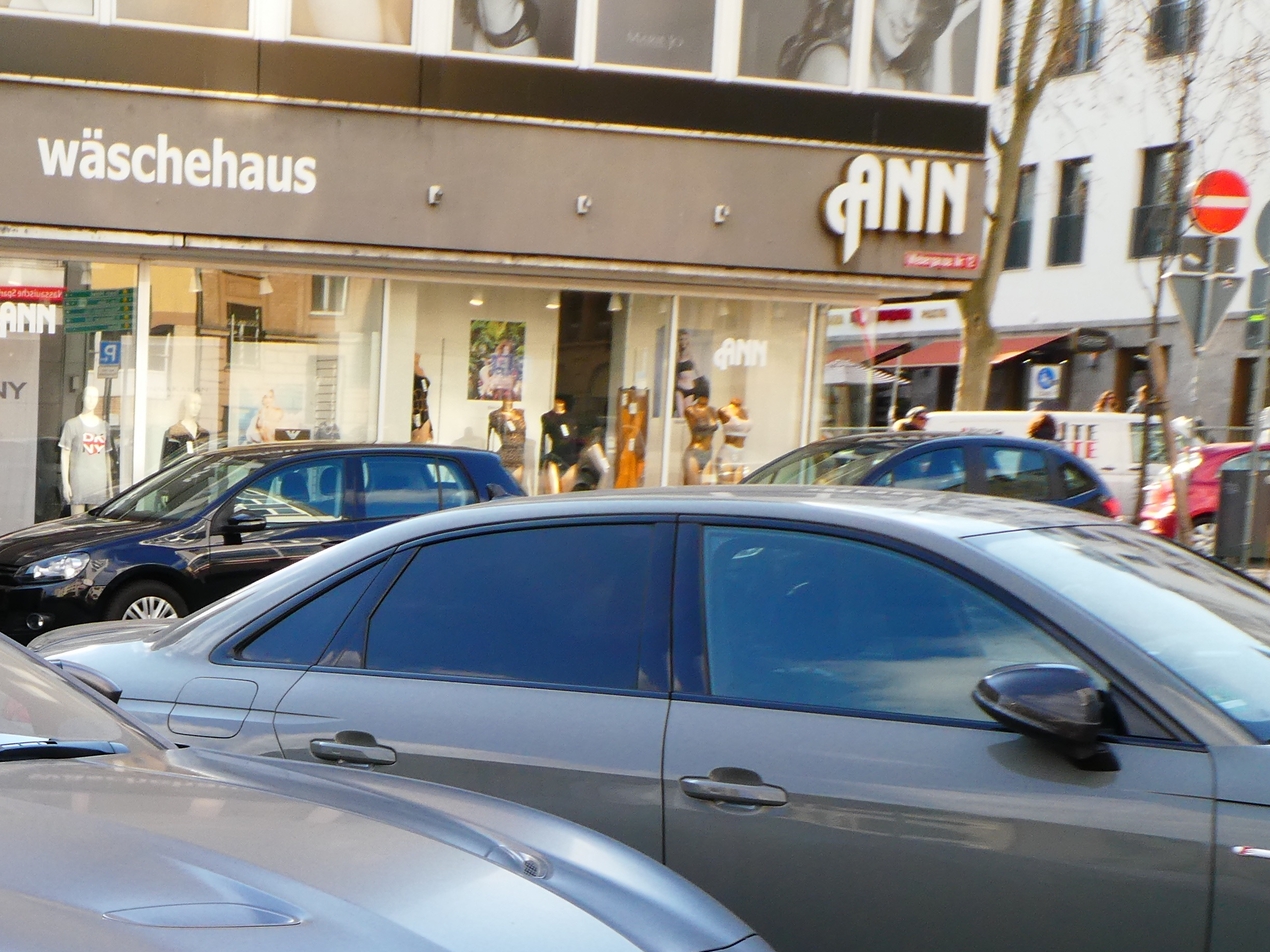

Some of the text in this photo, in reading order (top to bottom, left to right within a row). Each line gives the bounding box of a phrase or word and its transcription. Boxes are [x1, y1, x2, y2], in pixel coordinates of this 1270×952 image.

[38, 127, 317, 194] wäschehaus
[825, 153, 970, 264] ANN
[713, 337, 768, 371] ANN
